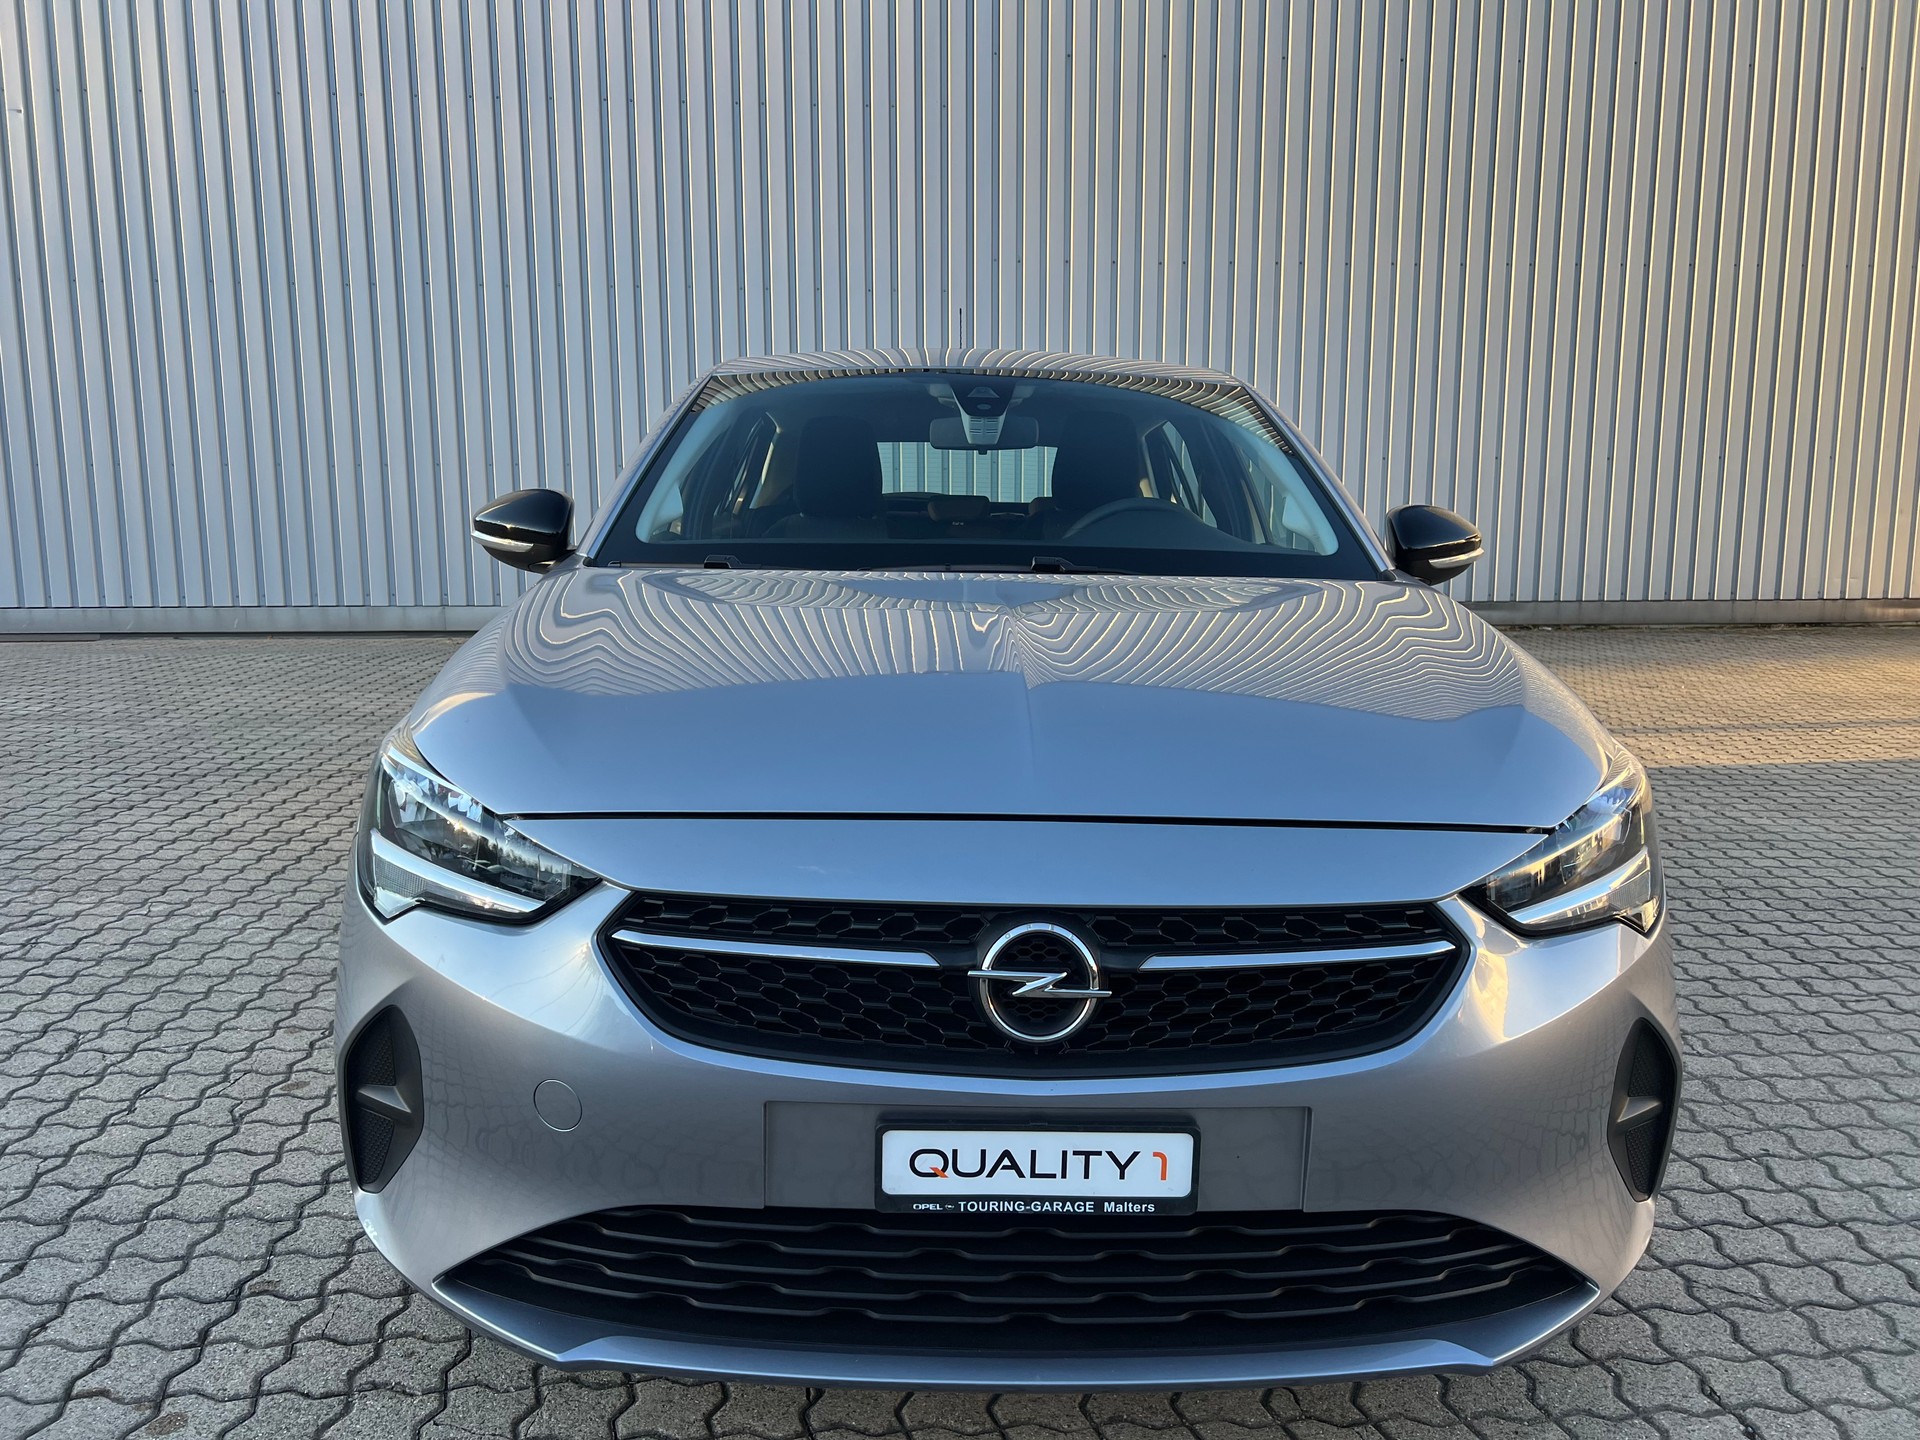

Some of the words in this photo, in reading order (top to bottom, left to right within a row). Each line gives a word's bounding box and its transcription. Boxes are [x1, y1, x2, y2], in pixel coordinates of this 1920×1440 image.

[909, 1148, 1141, 1181] QUALITY
[1152, 1151, 1168, 1181] 1
[912, 1203, 943, 1211] OPEL
[958, 1201, 1095, 1213] TOURING-GARAGE
[1103, 1201, 1155, 1213] Malters
